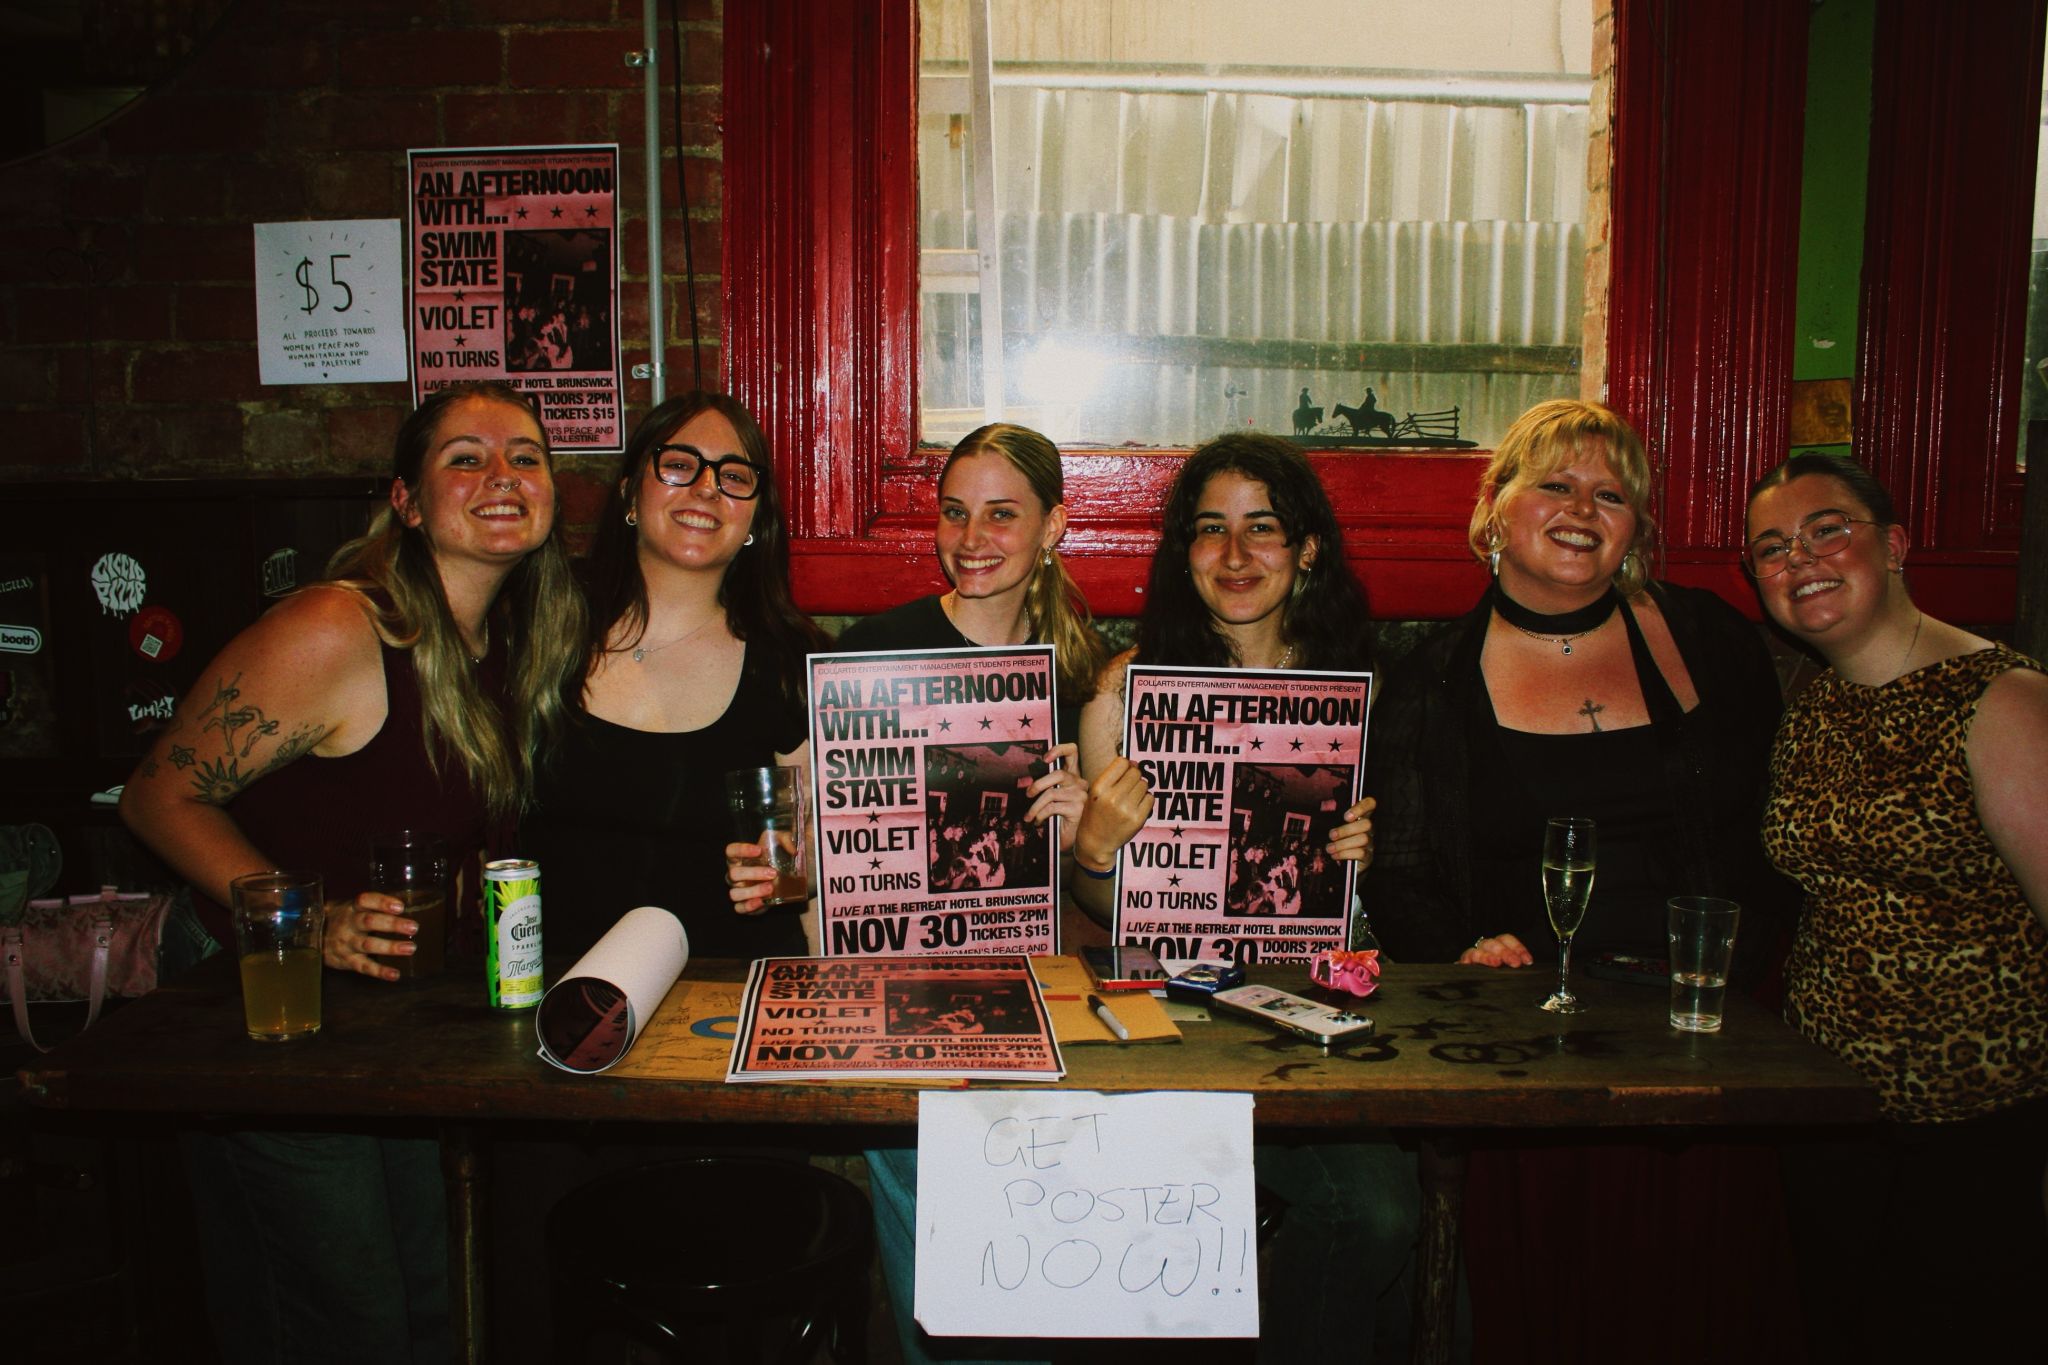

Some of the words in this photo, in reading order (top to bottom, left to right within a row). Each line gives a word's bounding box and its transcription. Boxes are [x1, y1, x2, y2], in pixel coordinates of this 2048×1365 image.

[450, 159, 500, 167] ENTERTAINMENT
[502, 157, 546, 165] MANAGEMENT
[418, 171, 453, 198] AN
[459, 168, 611, 197] AFTERNOON
[418, 197, 509, 226] WITH...
[421, 231, 497, 259] SWIM
[420, 259, 498, 287] STATE
[419, 305, 499, 331] VIOLET
[283, 332, 297, 341] ALL
[304, 328, 338, 338] PROCEEDS
[344, 327, 376, 335] TOWARDS
[318, 341, 341, 350] PEACE
[288, 351, 345, 360] HUMANITARIAN
[321, 359, 361, 368] PALESTINE
[421, 351, 443, 368] NO
[447, 350, 500, 368] TURNS
[424, 380, 448, 390] LIVE
[525, 378, 554, 389] HOTEL
[556, 377, 613, 388] BRUNSWICK
[544, 393, 584, 405] DOORS
[587, 392, 613, 405] 2PM
[543, 408, 590, 420] TICKETS
[592, 407, 615, 420] $15
[552, 434, 600, 443] PALESTINE
[564, 426, 593, 434] PEACE
[595, 426, 614, 434] AND
[1, 633, 35, 646] booth
[818, 665, 857, 675] COLLARTS
[858, 663, 918, 673] ENTERTAINMENT
[920, 661, 971, 671] MANAGEMENT
[973, 660, 1011, 669] STUDENTS
[1012, 658, 1045, 667] PRESENT
[819, 679, 862, 709] AN
[869, 671, 1047, 708] AFTERNOON
[1137, 679, 1176, 688] COLLARTS
[1177, 681, 1236, 690] ENTERTAINMENT
[1237, 682, 1289, 691] MANAGEMENT
[1290, 684, 1328, 692] STUDENTS
[1329, 685, 1362, 693] PRESENT
[1135, 692, 1179, 721] AN
[1184, 693, 1361, 727] AFTERNOON
[819, 709, 929, 741] WITH...
[1134, 722, 1240, 755] WITH...
[825, 746, 916, 779] SWIM
[1138, 760, 1225, 791] SWIM
[825, 778, 918, 809] STATE
[1149, 791, 1223, 821] TATE
[826, 826, 920, 855] VIOLET
[1129, 842, 1222, 869] VIOLET
[829, 876, 856, 894] NO
[859, 872, 921, 892] TURNS
[832, 905, 861, 917] LIVE
[863, 905, 876, 915] AT
[878, 904, 898, 915] THE
[900, 901, 946, 913] RETREAT
[949, 897, 983, 909] HOTEL
[985, 893, 1050, 907] BRUNSWICK
[1126, 891, 1153, 909] NO
[1156, 891, 1218, 910] TURNS
[971, 911, 1016, 925] DOORS
[1019, 909, 1048, 922] 2PM
[511, 923, 542, 941] Cuer
[832, 916, 910, 955] NOV
[920, 912, 967, 949] 30
[969, 927, 1021, 941] TICKETS
[1025, 924, 1050, 939] $15
[1126, 922, 1156, 933] LIVE
[1156, 923, 1171, 933] AT
[1173, 923, 1193, 933] THE
[1194, 923, 1240, 934] RETREAT
[1243, 924, 1276, 935] HOTEL
[1279, 924, 1342, 936] BRUNSWICK
[993, 945, 1025, 954] PEACE
[1027, 943, 1048, 952] AND
[1263, 941, 1307, 953] DOORS
[825, 962, 1022, 973] AFTERNOON
[772, 980, 874, 990] SWIM
[769, 989, 876, 1000] STATE
[765, 1006, 878, 1020] VIOLET
[761, 1027, 794, 1036] NO
[801, 1025, 877, 1035] TURNS
[756, 1045, 860, 1061] NOV
[873, 1044, 936, 1060] 30
[941, 1044, 1003, 1052] DOORS
[941, 1051, 1010, 1059] TICKETS
[1013, 1051, 1048, 1059] $15
[983, 1112, 1108, 1170] GET
[1003, 1178, 1222, 1225] POSTER
[980, 1226, 1247, 1297] NOW!!
